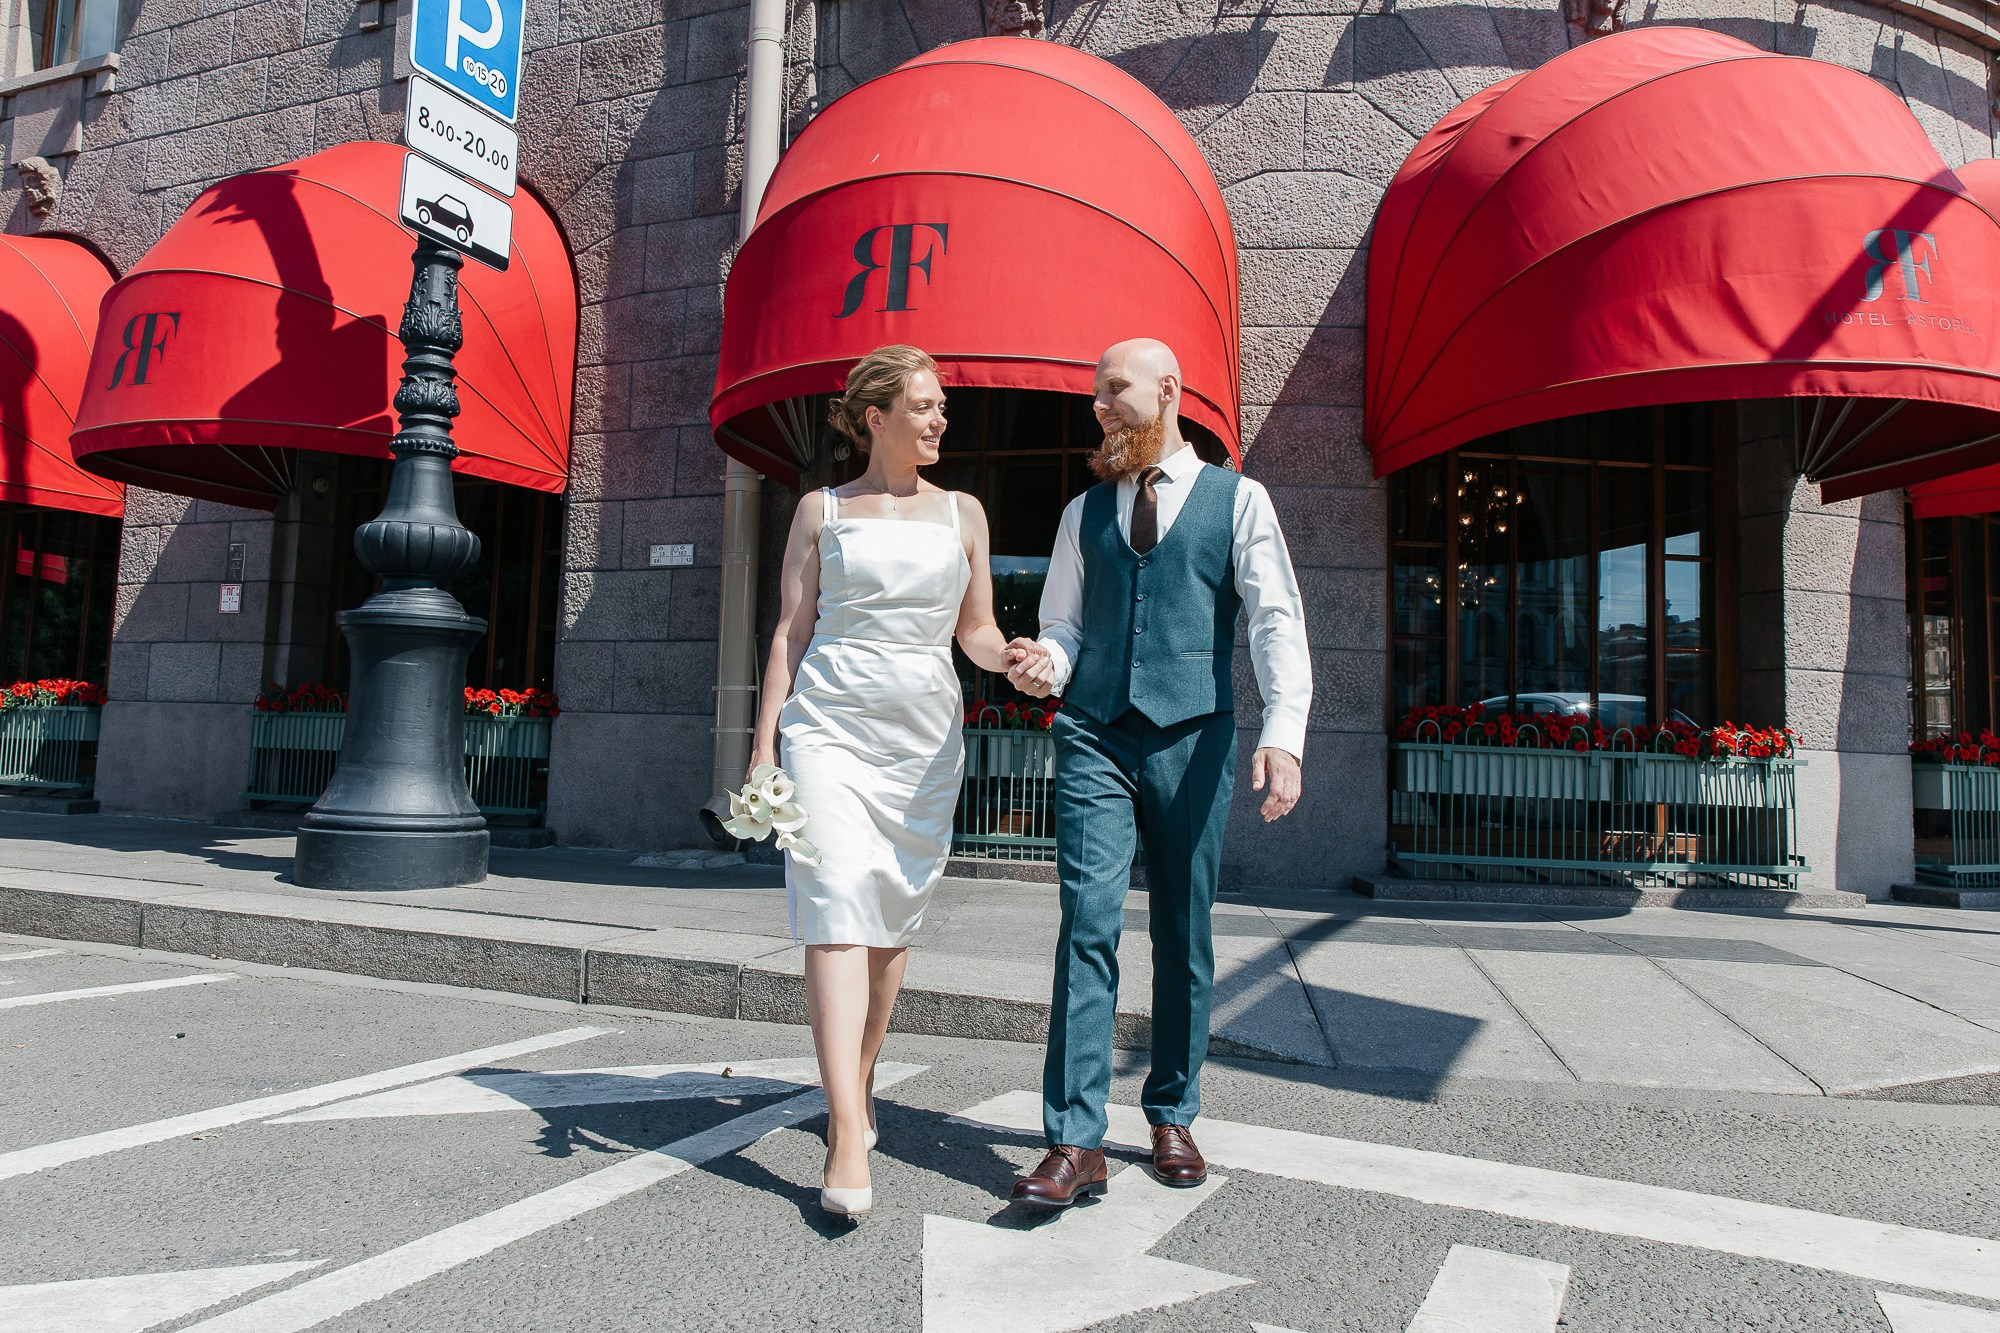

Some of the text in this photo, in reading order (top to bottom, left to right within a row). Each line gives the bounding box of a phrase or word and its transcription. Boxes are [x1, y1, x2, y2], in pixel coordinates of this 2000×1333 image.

[445, 0, 503, 72] P
[465, 60, 506, 93] 10 15 20
[418, 106, 509, 171] 8.00-20.00
[1825, 311, 1977, 336] HOTEL ASTORIA
